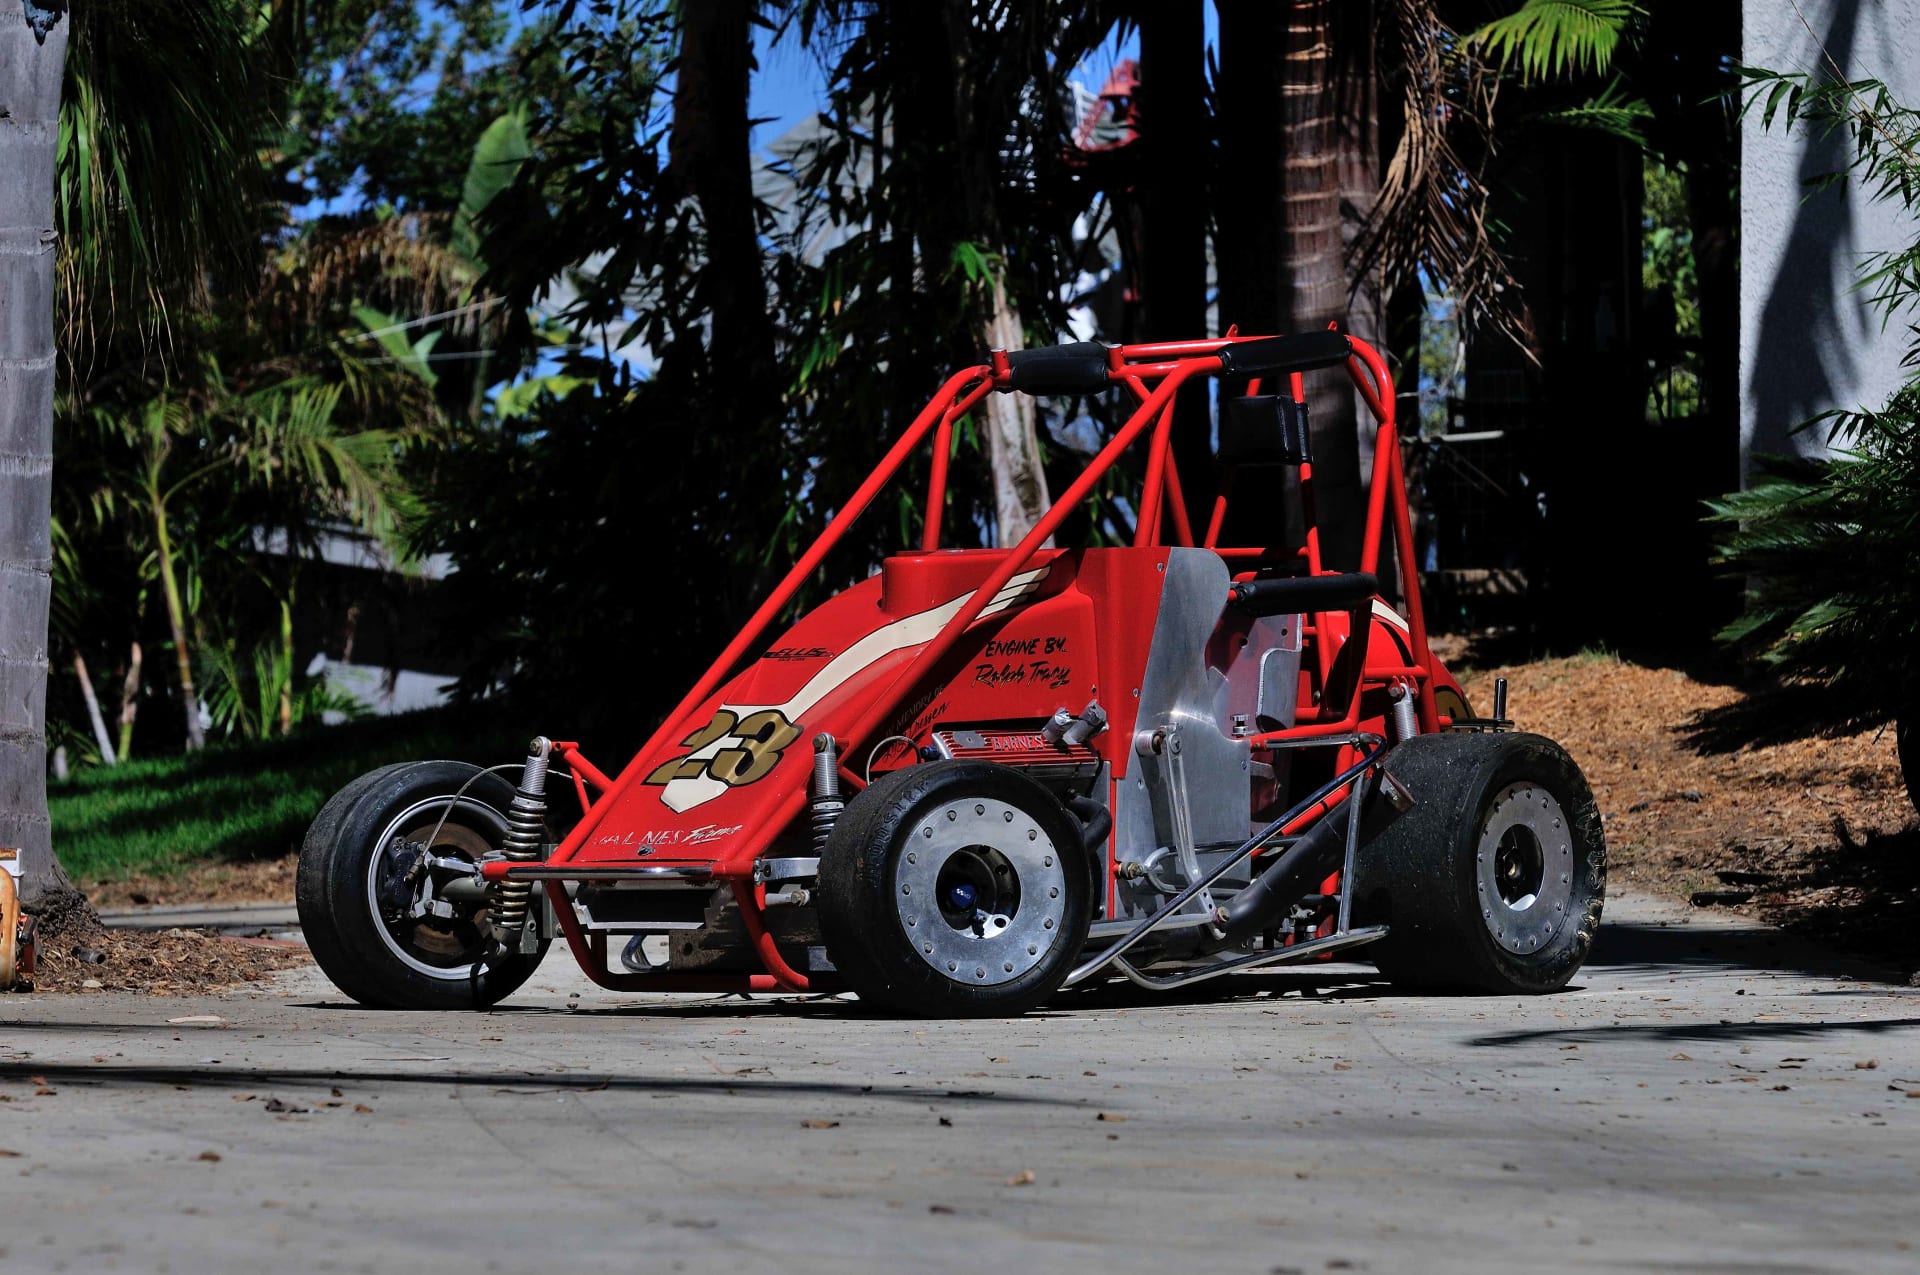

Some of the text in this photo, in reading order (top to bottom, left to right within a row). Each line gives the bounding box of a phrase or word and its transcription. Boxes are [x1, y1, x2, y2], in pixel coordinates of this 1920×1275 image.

[985, 638, 1040, 657] ENGINE
[972, 661, 1071, 689] Ralph Tracy
[641, 709, 804, 788] 23
[991, 735, 1045, 751] BARNES
